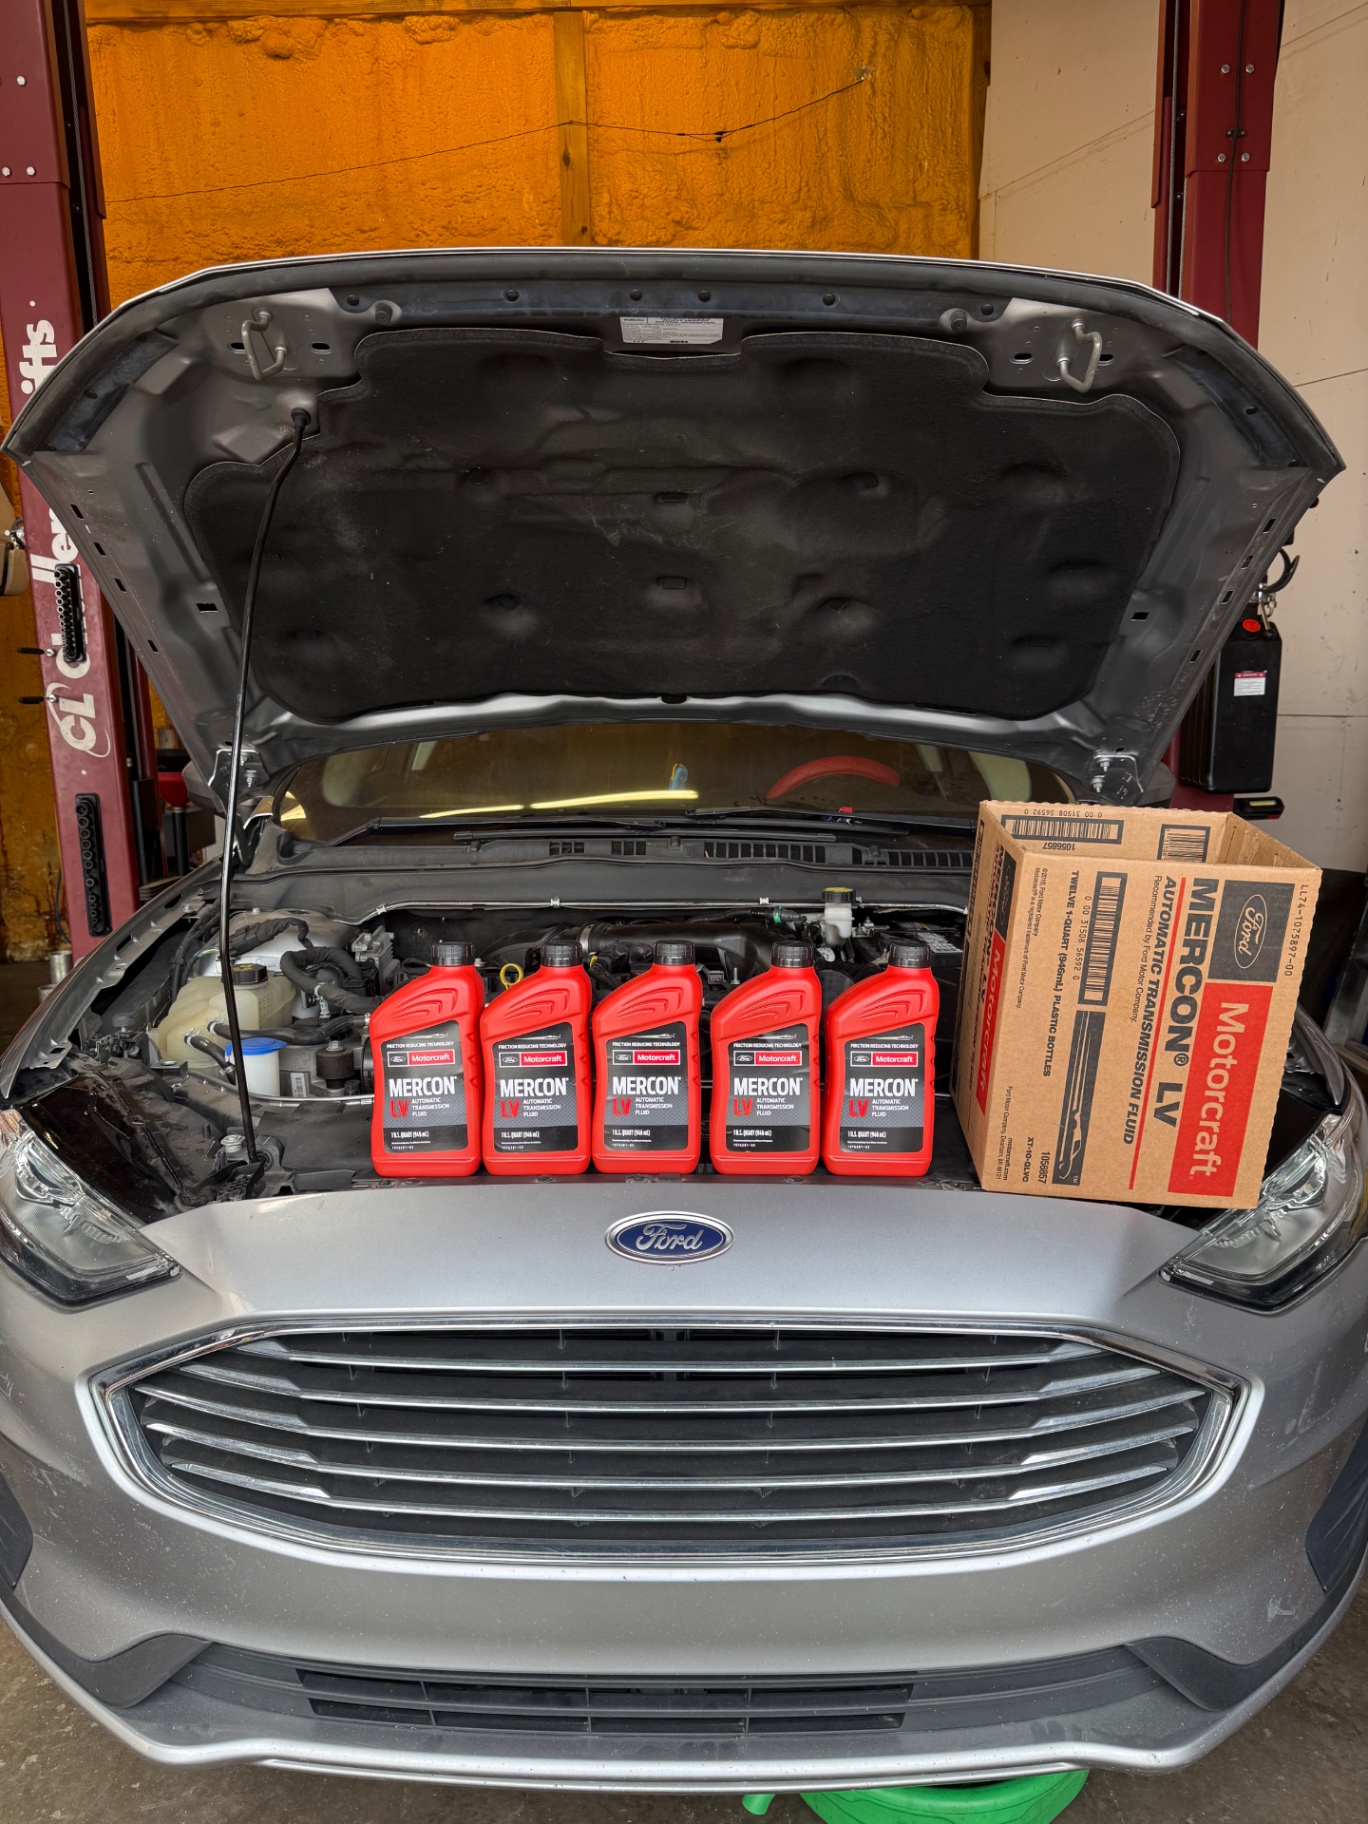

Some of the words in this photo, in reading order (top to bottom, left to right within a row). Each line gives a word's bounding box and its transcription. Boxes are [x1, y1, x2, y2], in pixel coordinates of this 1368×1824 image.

[19, 319, 58, 395] ifts
[1032, 808, 1055, 816] 56592
[1058, 810, 1081, 818] 31508
[1042, 842, 1076, 851] 1056857
[1066, 870, 1079, 908] TWELVE
[1082, 905, 1090, 915] 00
[1146, 875, 1162, 933] Recommended
[1061, 910, 1073, 950] 1-QUART
[1077, 919, 1088, 943] 31508
[1151, 877, 1176, 975] AUTOMATIC
[1238, 905, 1266, 957] Ford
[1284, 884, 1308, 976] LL74-1075897-00
[1142, 934, 1152, 944] by
[1073, 947, 1084, 971] 56592
[1141, 945, 1151, 962] Ford
[1053, 952, 1067, 992] (946mL)
[1137, 964, 1147, 986] Motor
[1049, 995, 1061, 1033] PLASTIC
[1129, 987, 1143, 1022] Company.
[979, 946, 1000, 1095] Motorcraft
[1130, 980, 1159, 1099] TRANSMISSION
[412, 1053, 451, 1062] Motorcraft
[524, 1055, 563, 1063] Motorcraft
[637, 1053, 676, 1061] Motorcraft
[758, 1054, 797, 1062] Motorcraft
[875, 1055, 914, 1063] Motorcraft
[1043, 1035, 1055, 1076] BOTTLES
[1191, 1003, 1248, 1174] Motorcraft
[389, 1099, 409, 1118] LV
[501, 1099, 520, 1118] LV
[612, 1097, 632, 1116] LV
[733, 1097, 753, 1117] LV
[849, 1098, 869, 1118] LV
[1153, 1082, 1183, 1127] LV
[1123, 1102, 1139, 1144] FLUID
[1003, 1137, 1012, 1180] motorcraft.com
[1038, 1151, 1050, 1184] 1056857
[635, 1223, 705, 1250] Ford
